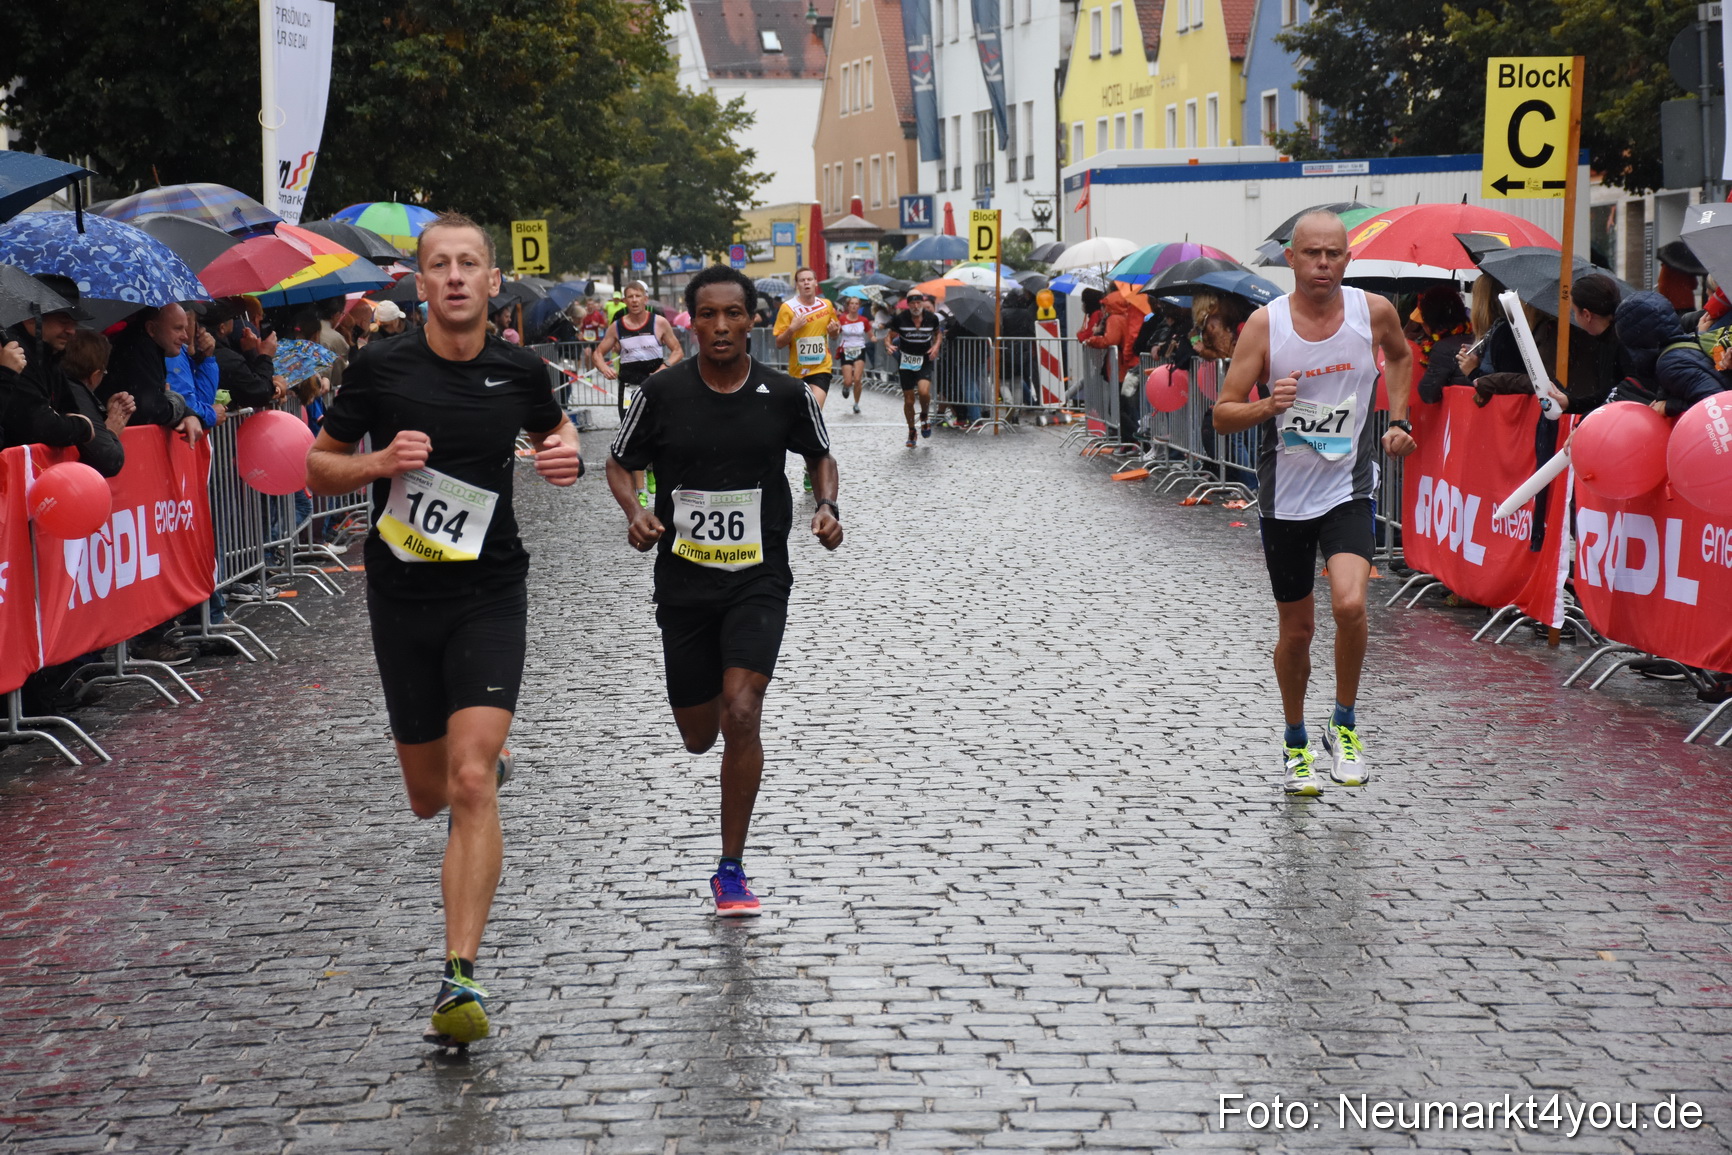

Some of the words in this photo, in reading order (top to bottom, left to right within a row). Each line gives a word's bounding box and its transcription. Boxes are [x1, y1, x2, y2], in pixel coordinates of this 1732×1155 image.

[1498, 63, 1572, 88] Block
[1508, 99, 1556, 169] C
[516, 222, 543, 233] Block
[973, 211, 998, 222] Block
[522, 237, 540, 262] D
[977, 226, 994, 251] D
[799, 343, 824, 355] 2708
[1305, 363, 1355, 378] KLEBL
[439, 480, 489, 507] BOCK
[710, 492, 754, 505] BOCK
[406, 491, 470, 544] 164
[689, 510, 745, 541] 236
[403, 534, 444, 561] Albert
[678, 543, 711, 561] Girma
[714, 548, 757, 563] Ayalew
